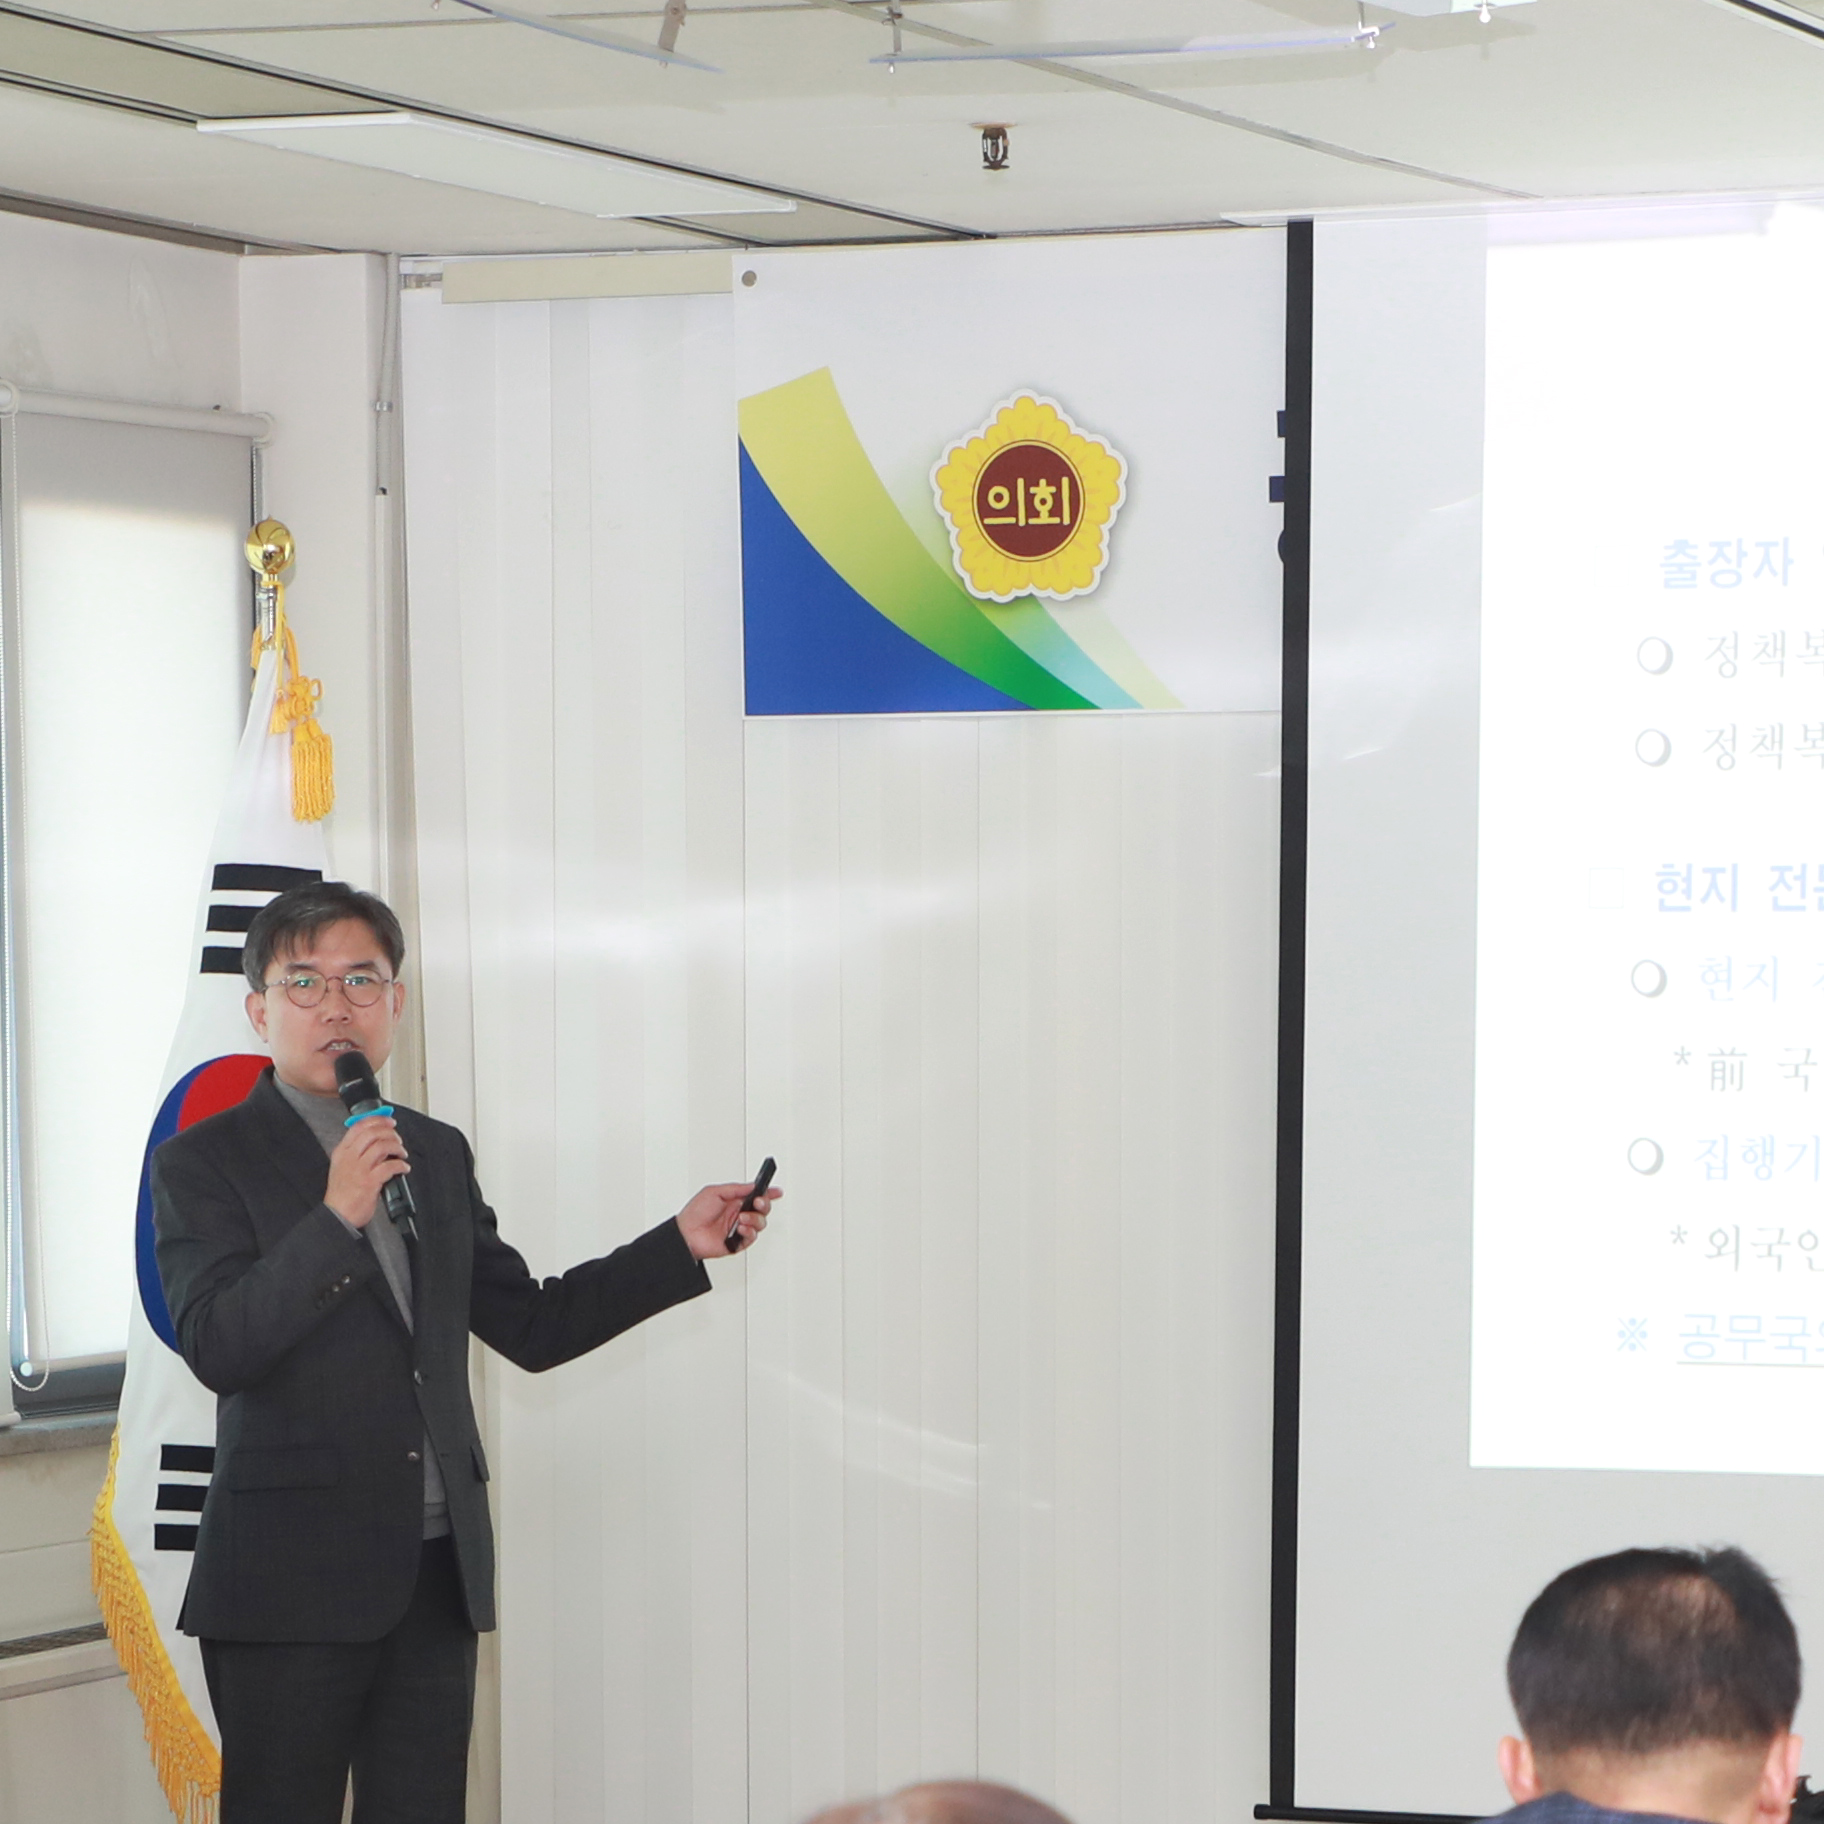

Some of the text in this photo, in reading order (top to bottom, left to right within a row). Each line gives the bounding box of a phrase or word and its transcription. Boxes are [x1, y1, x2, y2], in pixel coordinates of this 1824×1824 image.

[983, 476, 1071, 526] 의회
[1659, 535, 1795, 590] 출장자
[1654, 862, 1739, 913] 현지
[1699, 955, 1779, 1003] 현지
[1707, 1046, 1749, 1093] 前
